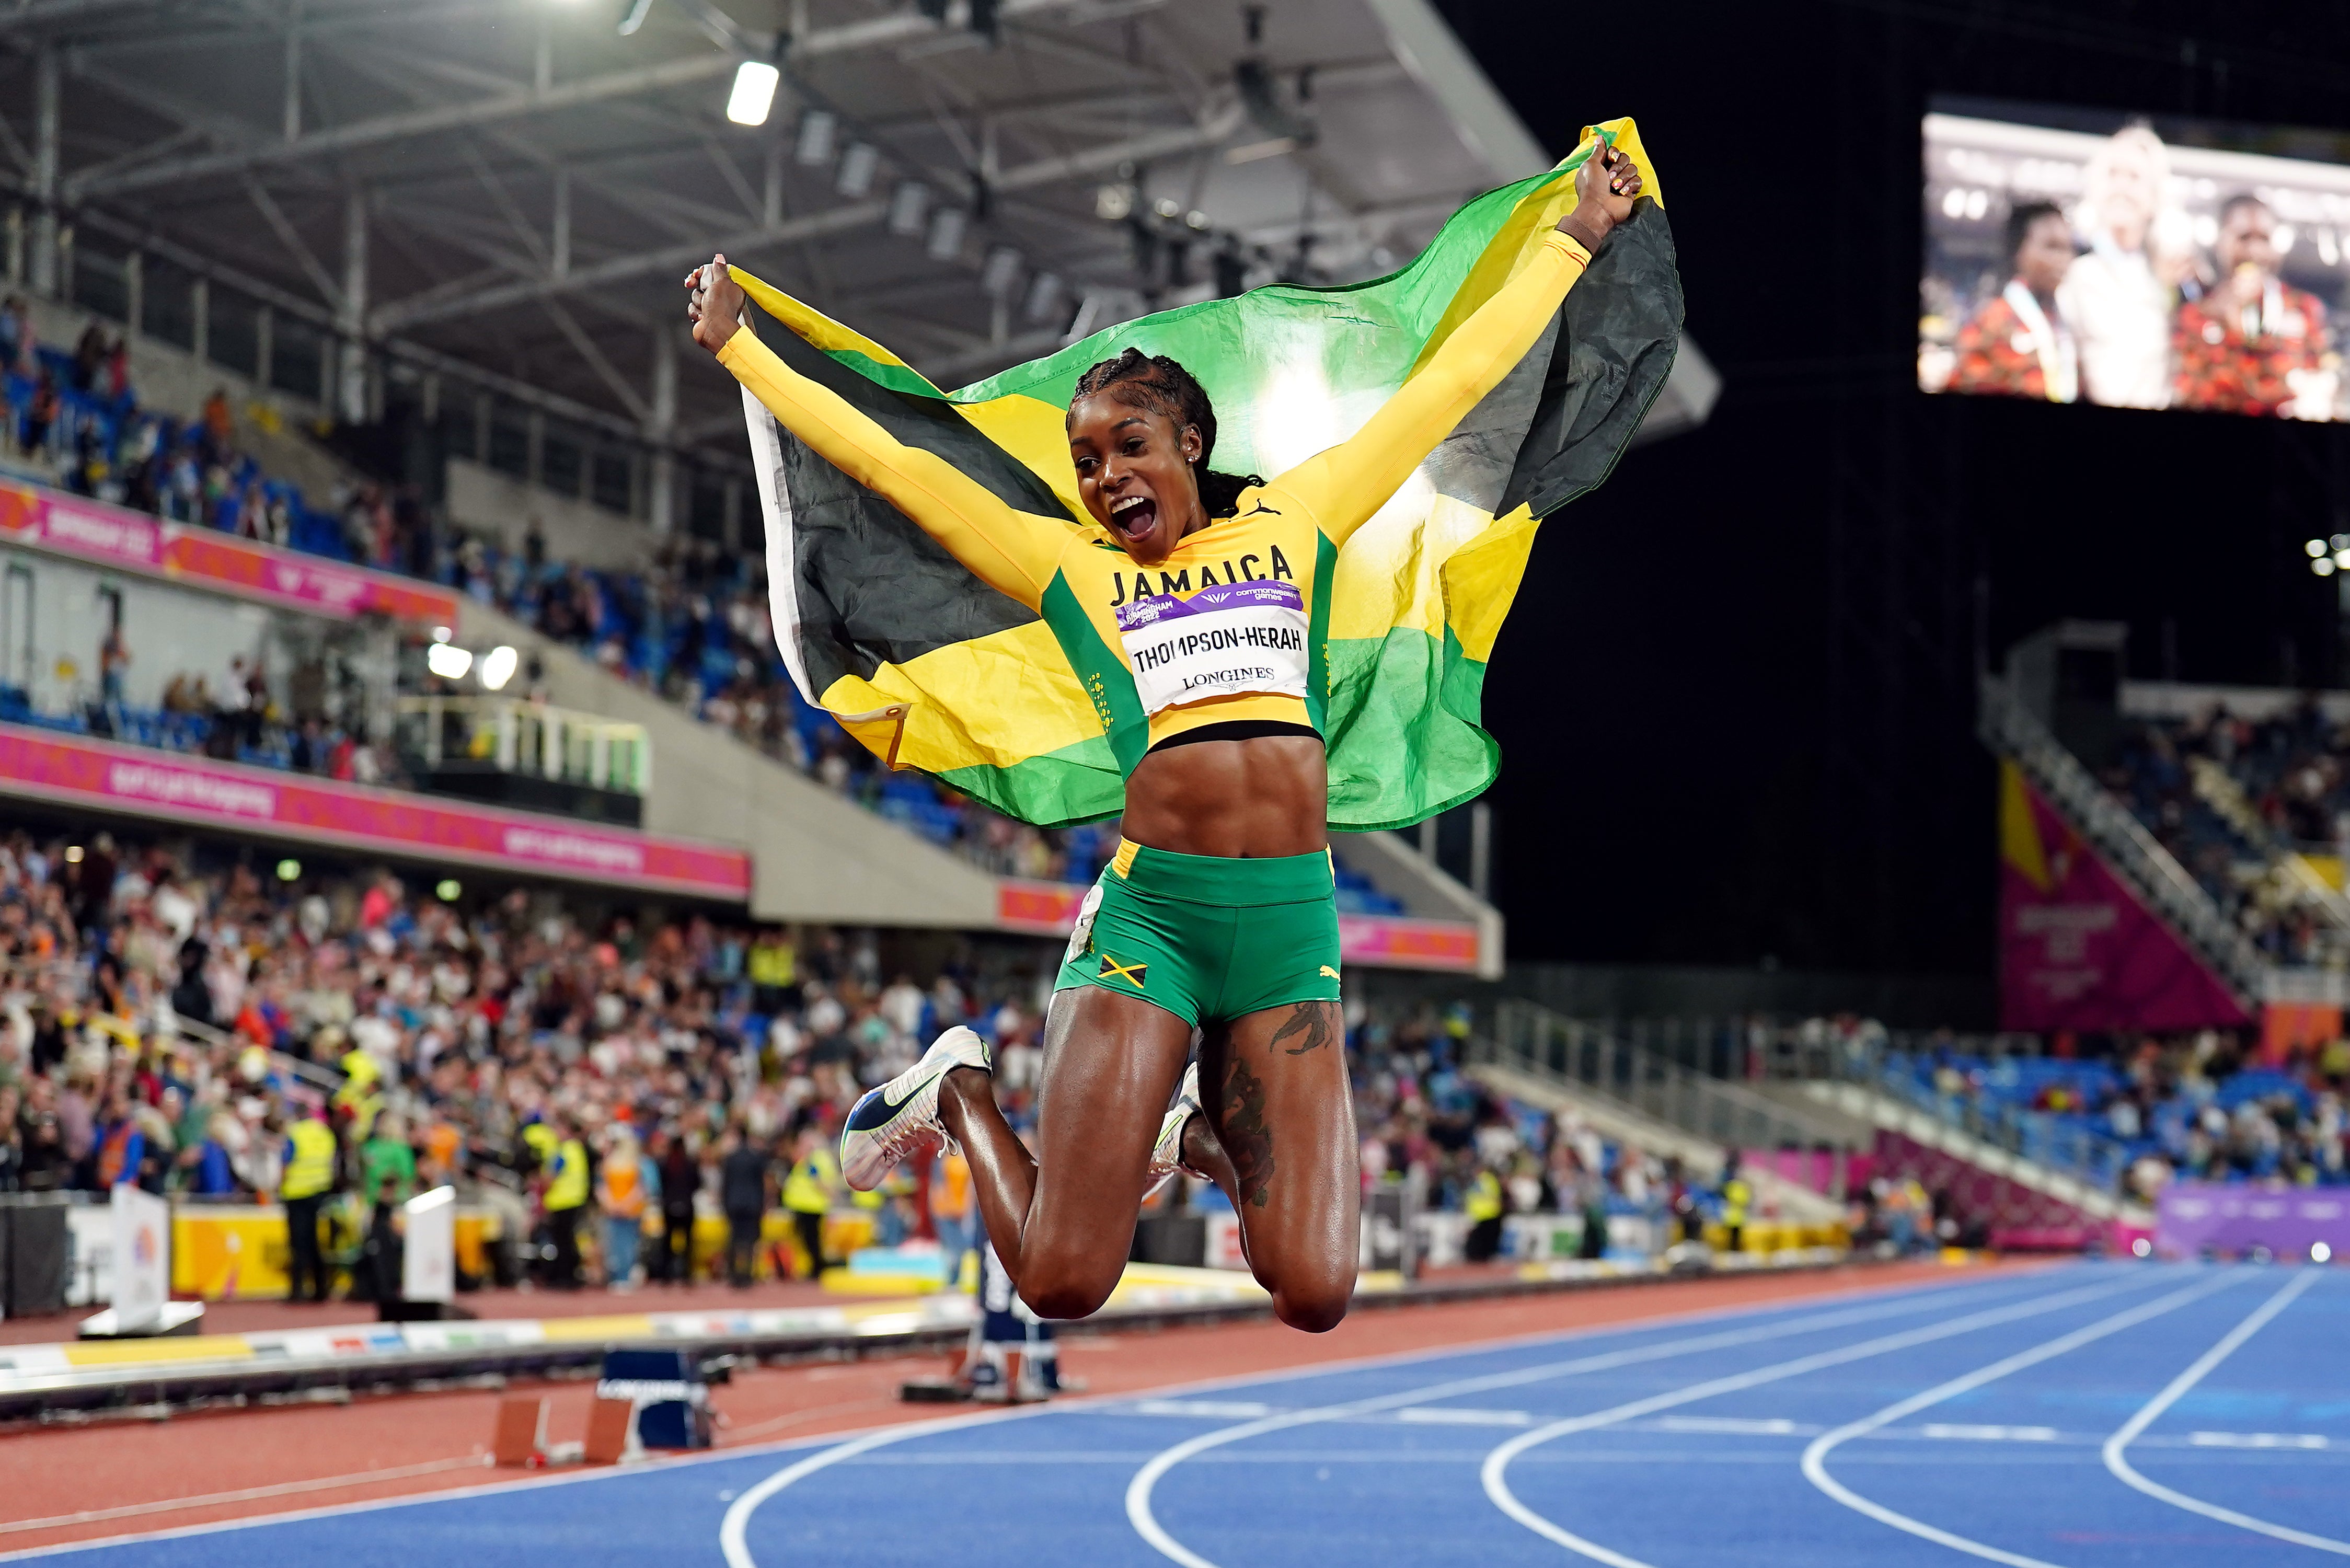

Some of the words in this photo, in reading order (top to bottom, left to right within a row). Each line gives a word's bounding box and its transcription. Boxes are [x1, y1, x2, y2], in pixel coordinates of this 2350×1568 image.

[1110, 544, 1294, 607] JAMAICA
[1236, 587, 1297, 599] commonwealth
[1254, 592, 1283, 601] games
[1125, 600, 1174, 624] BIRMINGHAM
[1141, 612, 1160, 624] 2022
[1134, 626, 1303, 673] THOMPSON-HERAH
[1182, 667, 1275, 690] LONGINES
